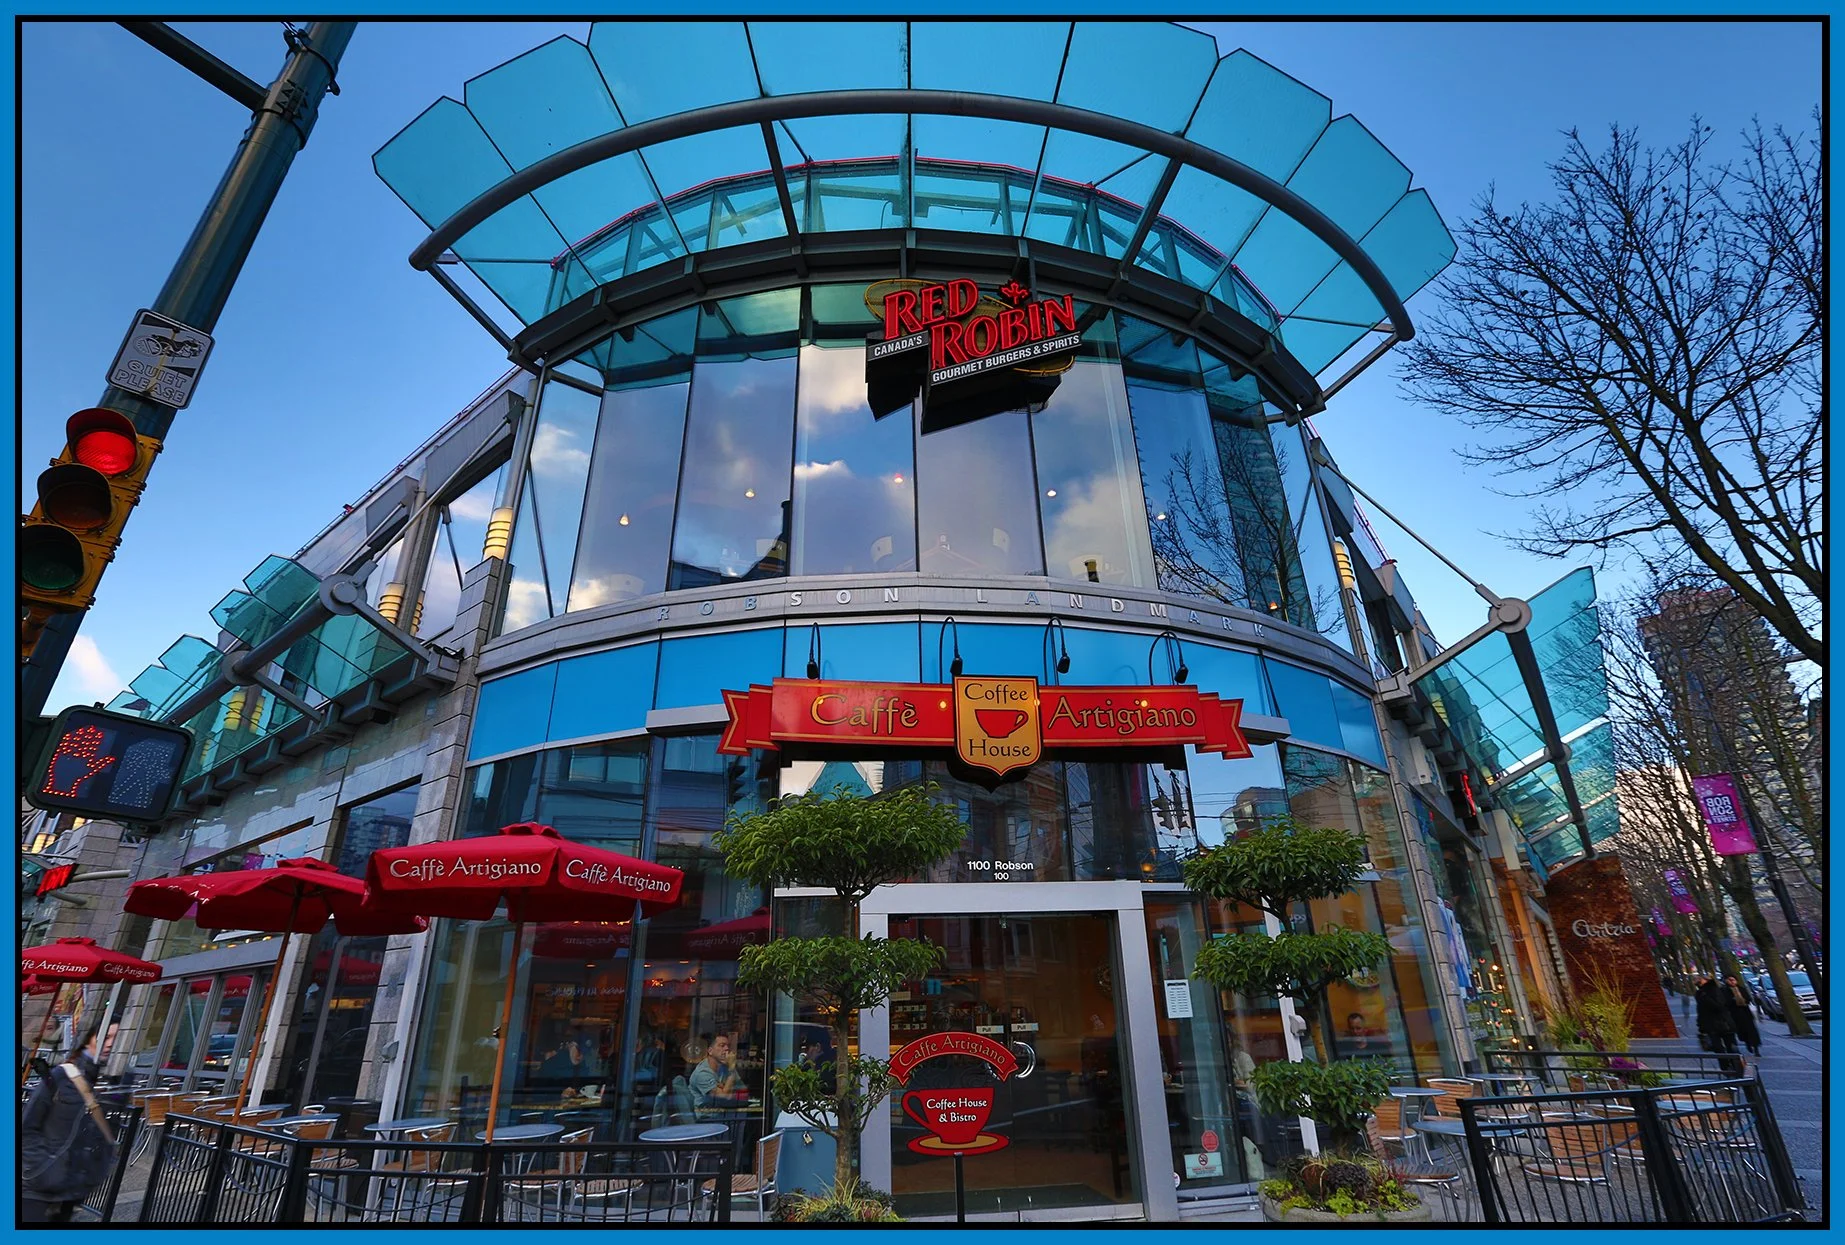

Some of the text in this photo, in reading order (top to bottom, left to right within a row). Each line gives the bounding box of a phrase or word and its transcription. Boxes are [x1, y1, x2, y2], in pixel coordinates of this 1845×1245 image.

[884, 278, 979, 341] RED
[930, 293, 1076, 371] ROBIN
[874, 335, 923, 357] CANADA'S
[932, 334, 1080, 382] GOURMET BURGERS & SPIRITS
[115, 369, 186, 403] PLEASE
[128, 360, 187, 389] QUIET
[657, 587, 1265, 638] ROBSON LANDMARK
[964, 682, 1028, 705] Coffee
[810, 693, 1198, 735] Caffè Artigiano
[969, 738, 1032, 758] House
[390, 856, 541, 881] Caffè Artigiano
[566, 859, 671, 892] Caffè Artigiano
[967, 861, 1034, 870] 1100 Robson
[994, 872, 1009, 880] 100
[35, 960, 88, 973] Artigiano
[941, 1035, 1006, 1066] Artigiano
[926, 1098, 988, 1110] Coffee House
[939, 1112, 977, 1122] & Bistro
